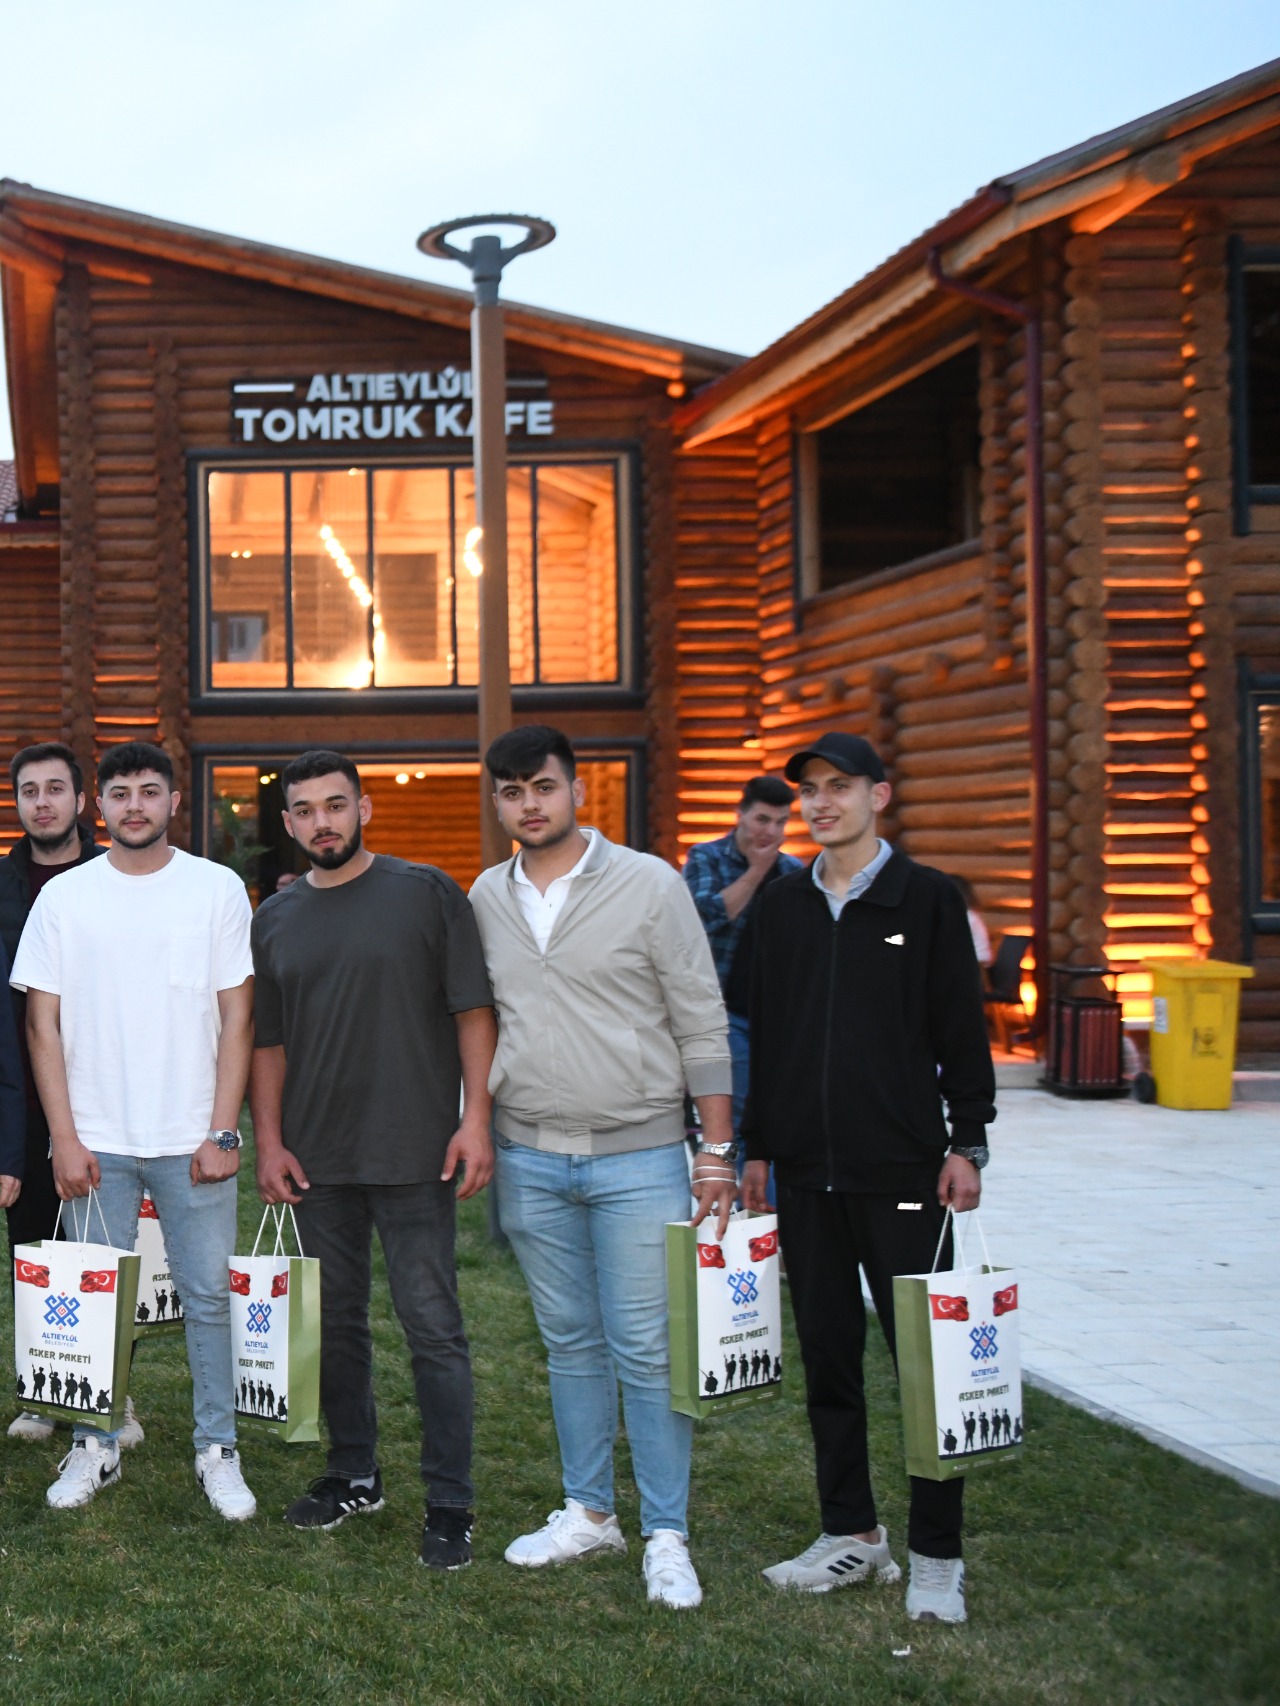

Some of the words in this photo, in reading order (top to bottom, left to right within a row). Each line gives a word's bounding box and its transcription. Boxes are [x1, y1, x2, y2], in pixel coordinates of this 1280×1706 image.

[234, 405, 423, 442] TOMRUK
[435, 401, 554, 437] KFE
[152, 1272, 173, 1282] ASKE
[719, 1333, 744, 1346] ASKER
[29, 1347, 56, 1360] ASKER
[959, 1389, 985, 1402] ASKER
